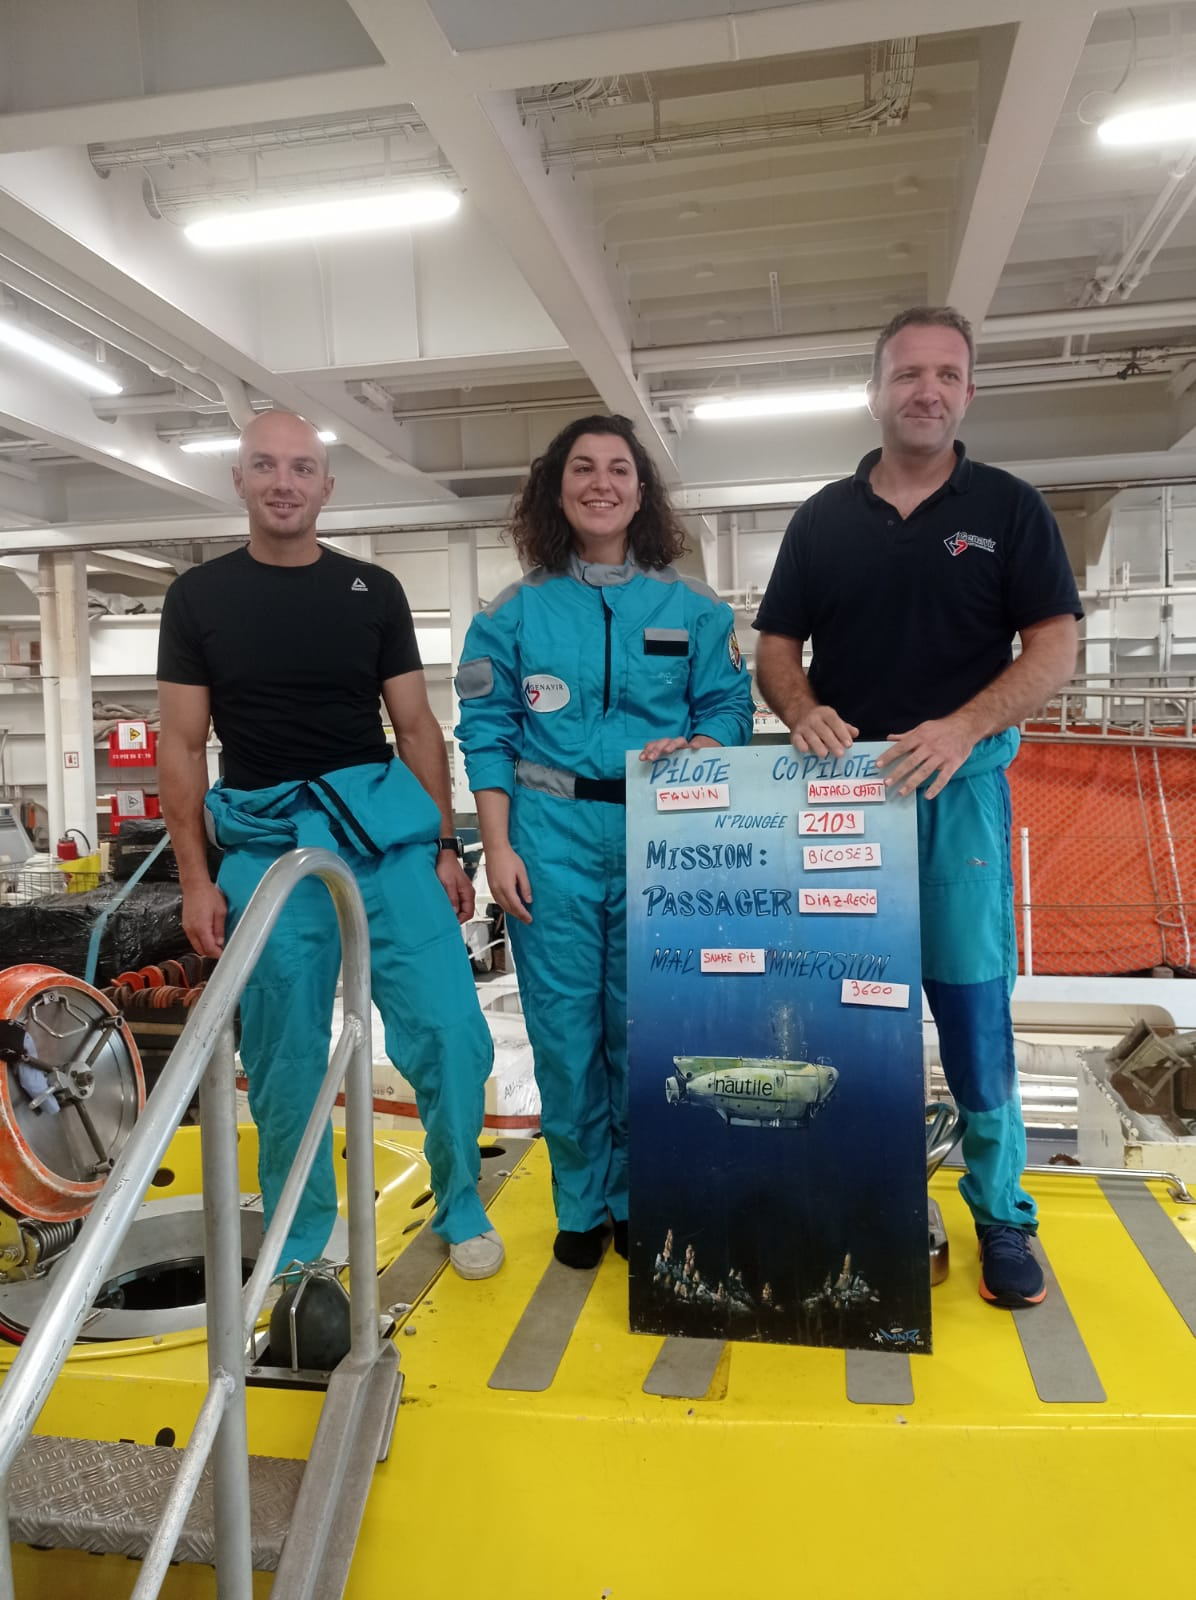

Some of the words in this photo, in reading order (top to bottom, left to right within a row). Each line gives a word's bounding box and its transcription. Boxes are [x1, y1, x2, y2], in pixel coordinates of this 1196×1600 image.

[529, 683, 564, 691] GENAVIR
[804, 812, 856, 833] 2109
[642, 885, 792, 917] PASSAGER
[703, 952, 732, 964] SNAKE
[851, 981, 893, 996] 3600
[715, 1078, 773, 1097] nautile
